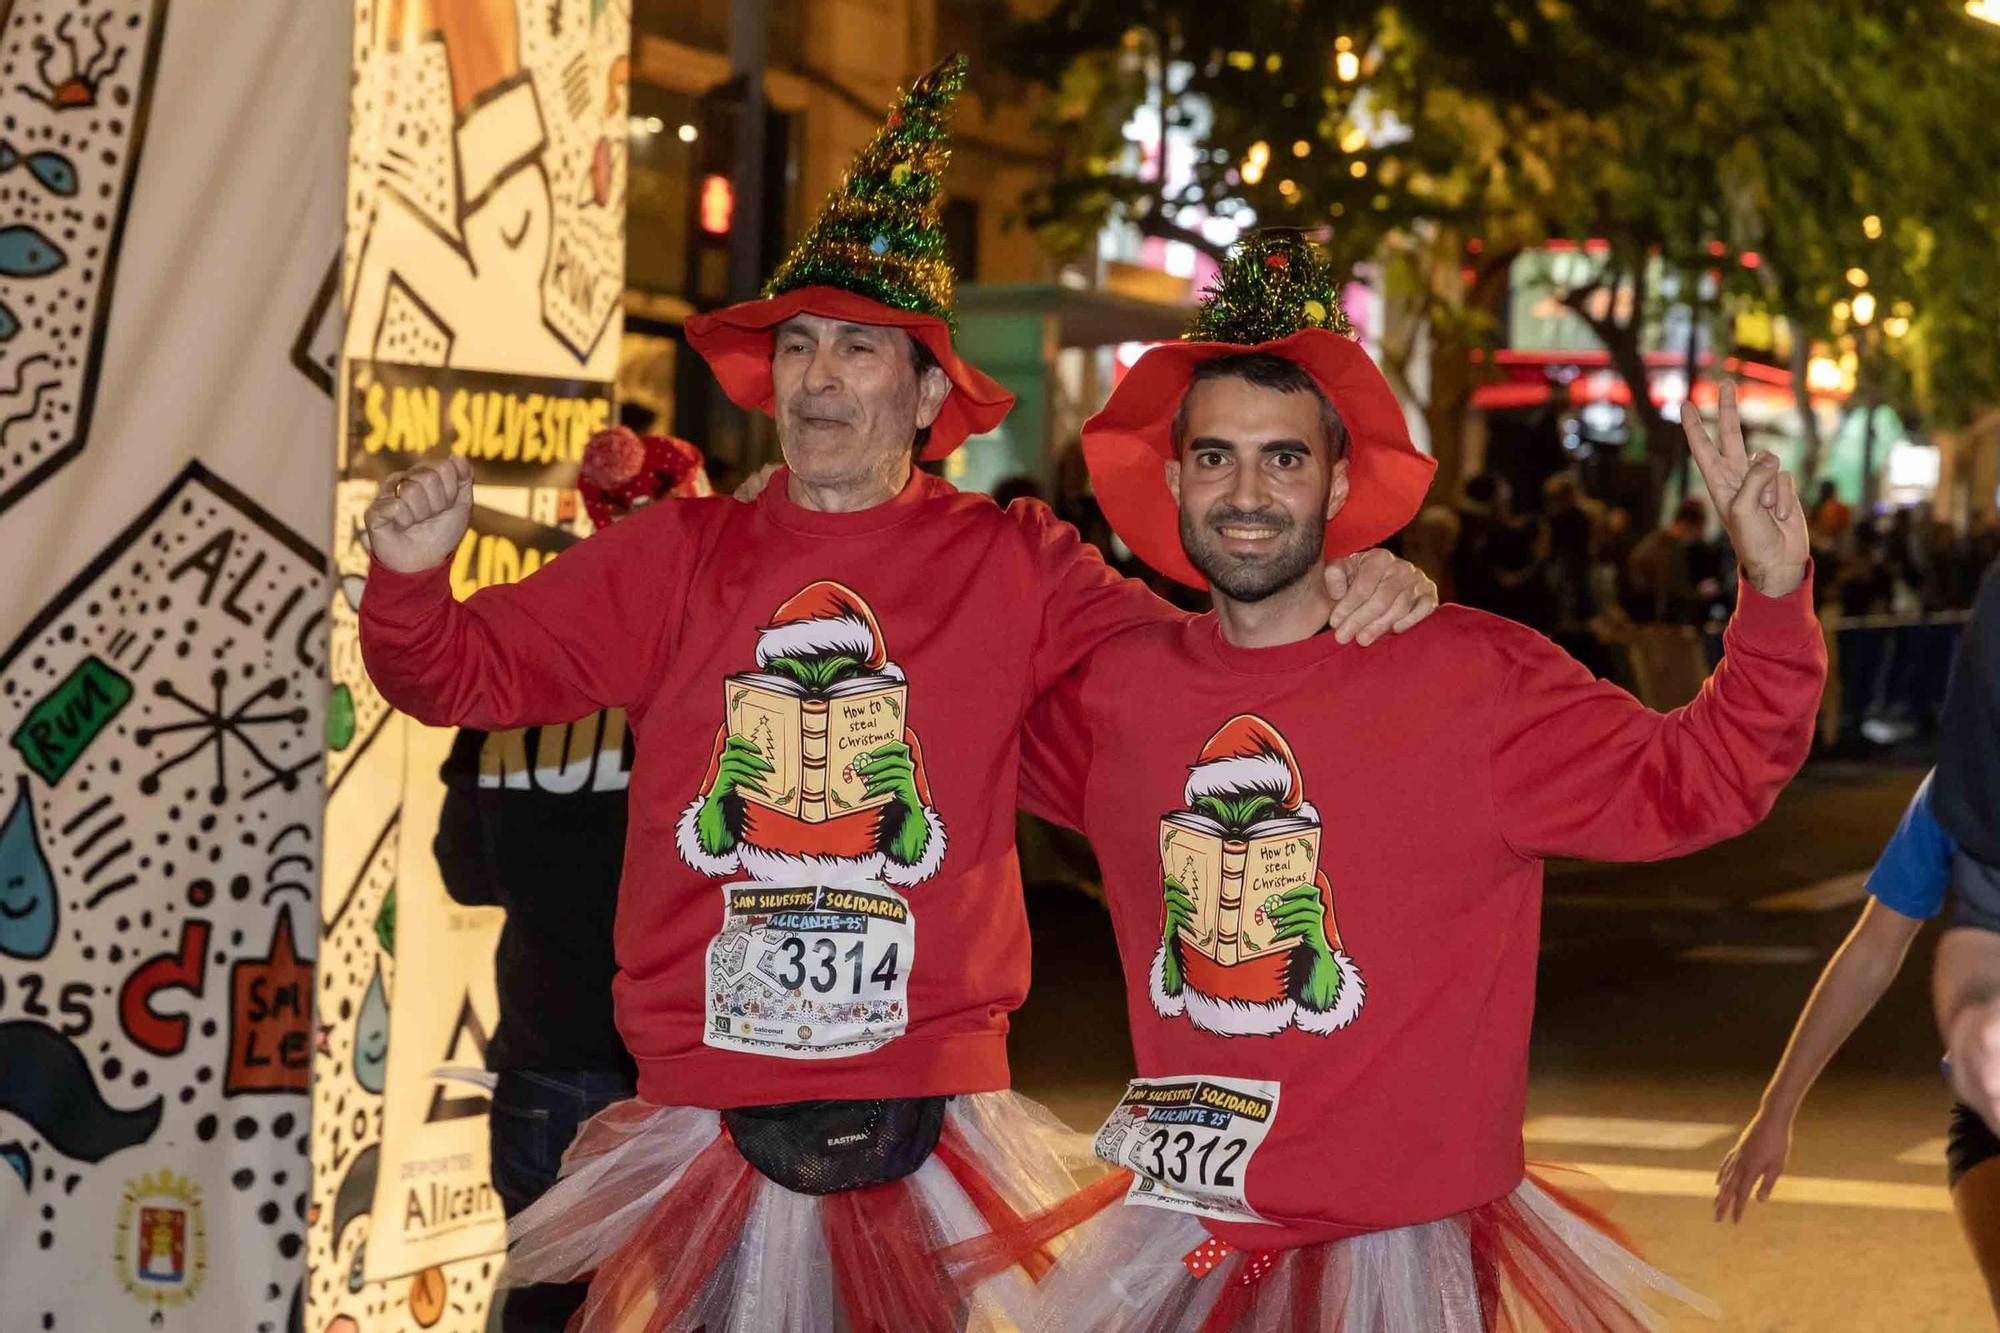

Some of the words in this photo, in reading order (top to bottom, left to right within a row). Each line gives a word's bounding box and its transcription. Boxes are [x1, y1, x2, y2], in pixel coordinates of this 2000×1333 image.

[364, 381, 441, 454] SAN
[842, 704, 868, 719] How
[869, 700, 882, 714] to
[29, 672, 112, 770] RUN
[849, 718, 878, 732] steal
[838, 729, 896, 750] Christmas
[1260, 846, 1284, 860] How
[1285, 842, 1297, 855] to
[1264, 862, 1291, 874] steal
[1252, 872, 1307, 891] Christmas
[733, 896, 756, 909] SAN
[760, 894, 813, 908] SILVESTRE
[825, 892, 905, 918] SOLIDARIA
[769, 914, 840, 930] ALICANTE
[779, 937, 898, 995] 3314
[0, 972, 95, 1037] 25
[1149, 1087, 1194, 1101] SILVESTRE
[1199, 1087, 1268, 1119] SOLIDARIA
[1150, 1109, 1205, 1123] ALICANTE
[827, 1131, 870, 1147] EASTPAK
[1146, 1128, 1248, 1187] 3312
